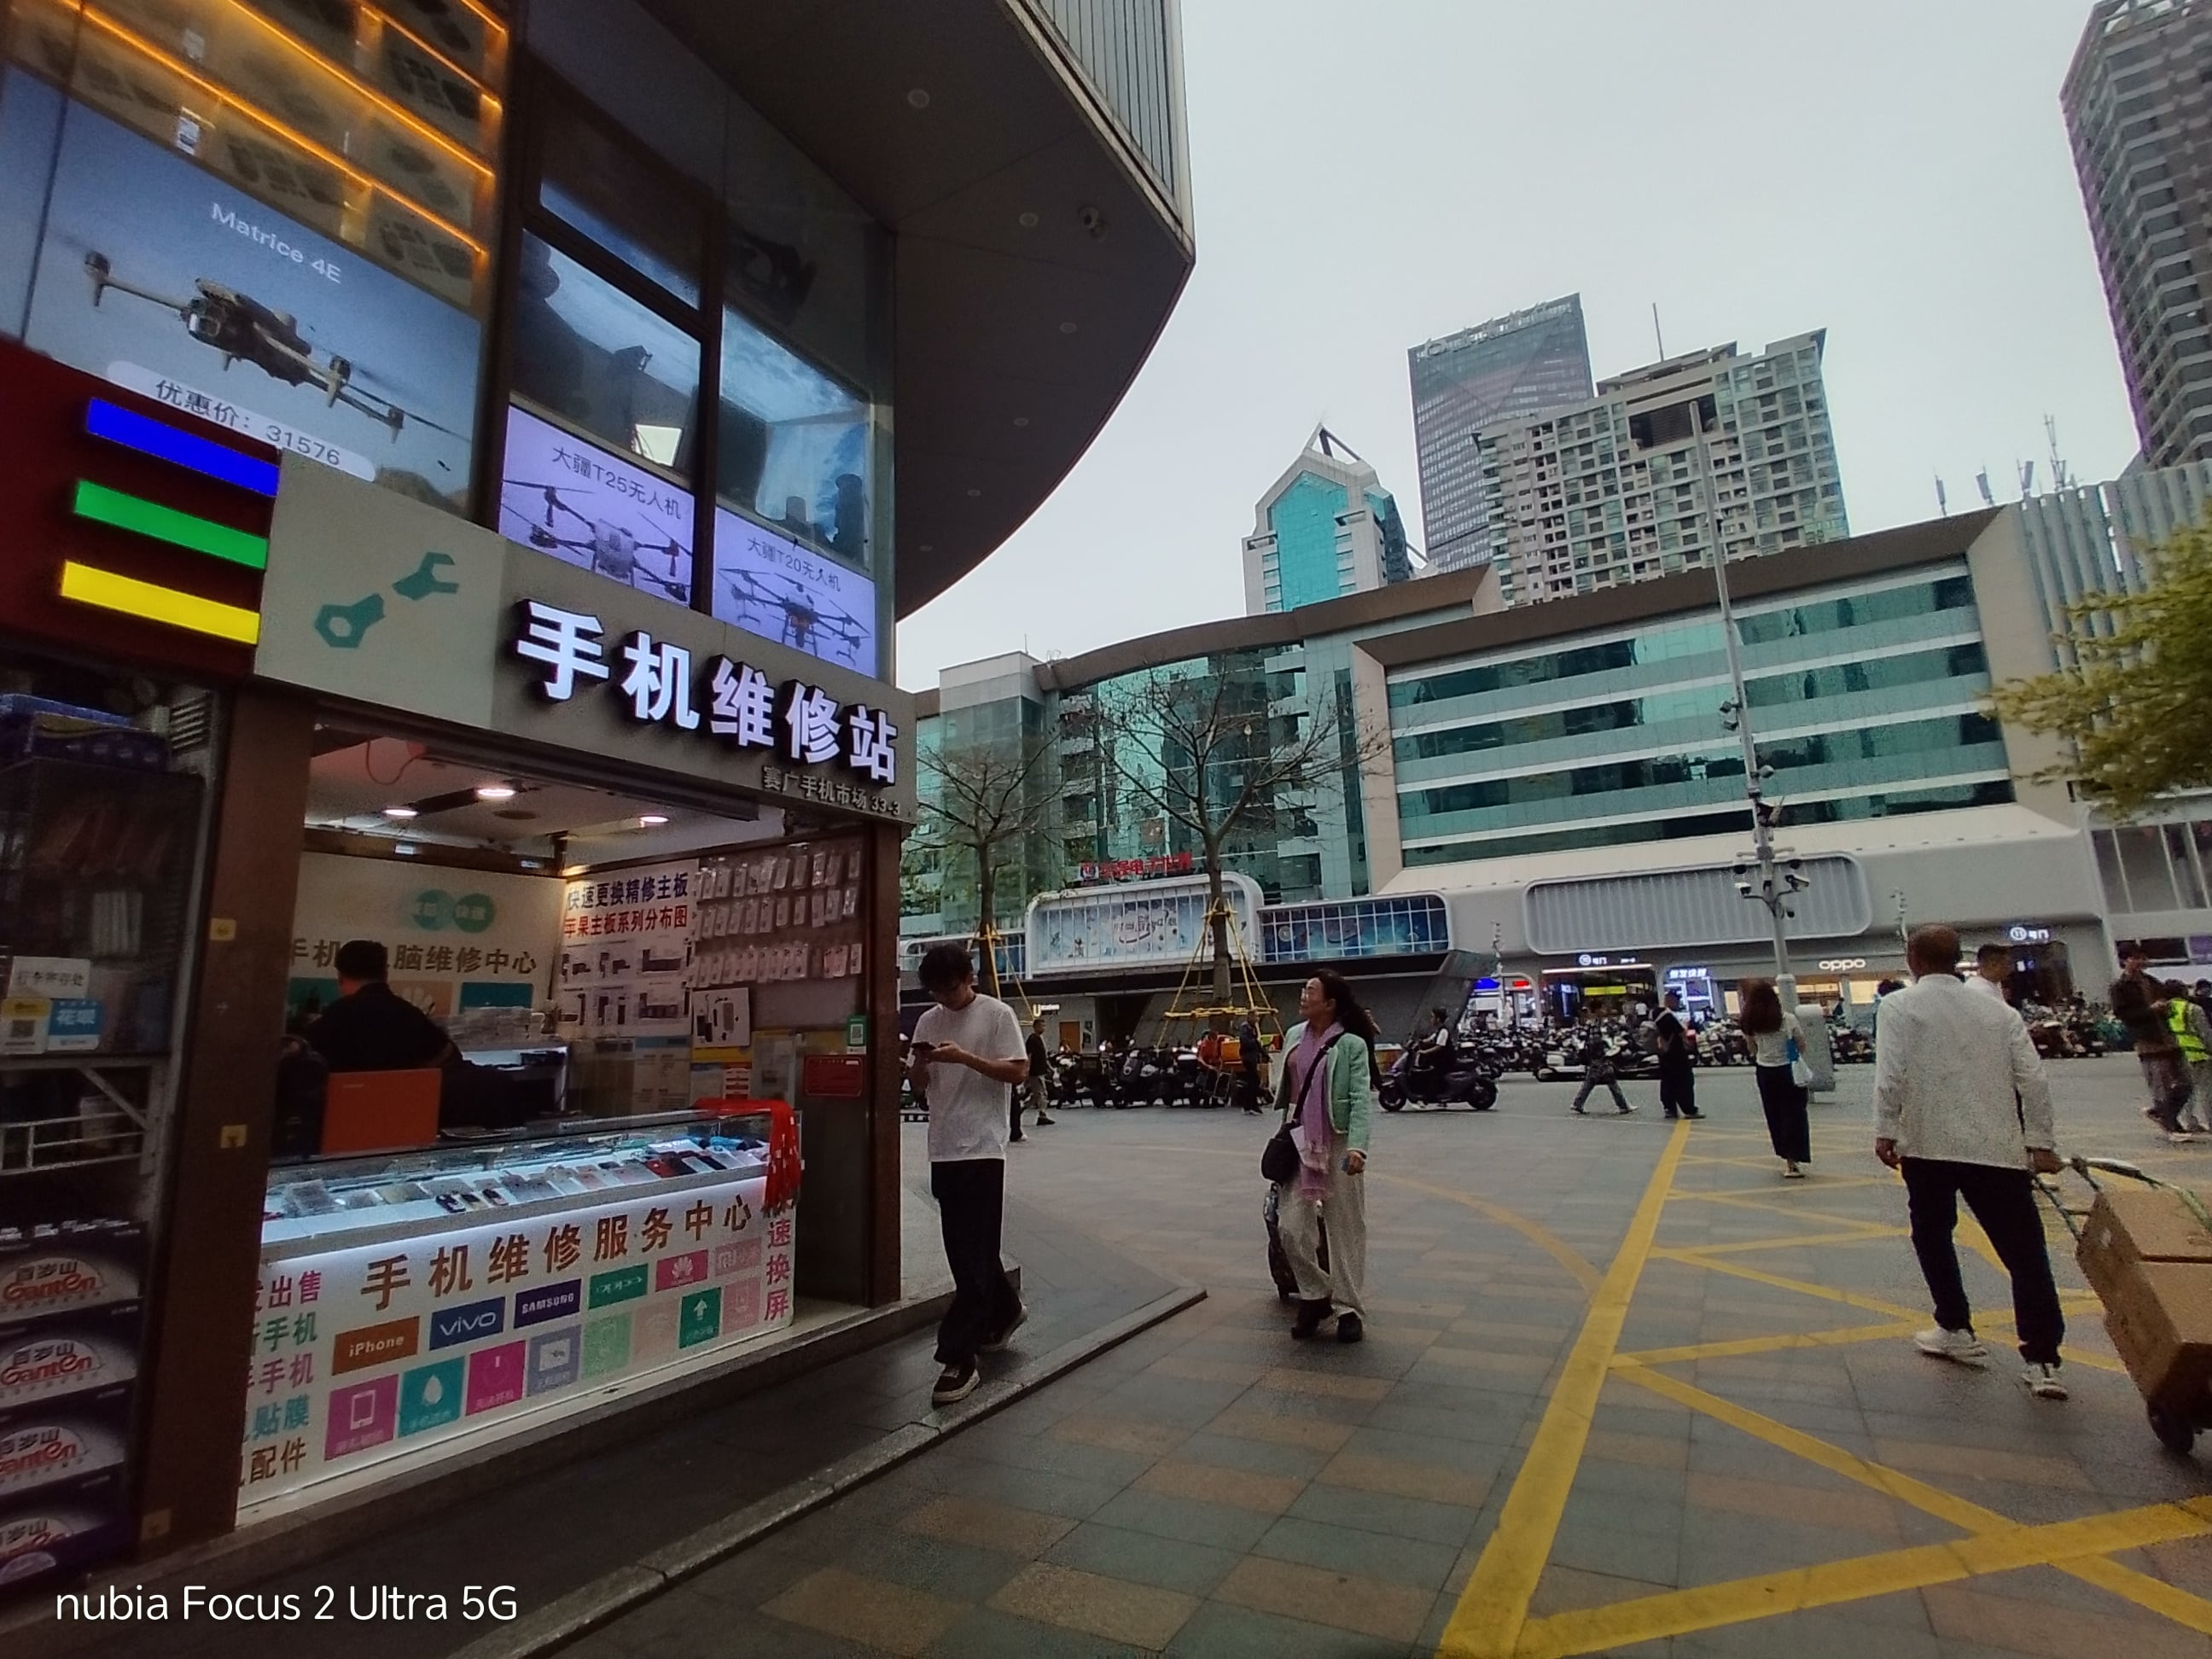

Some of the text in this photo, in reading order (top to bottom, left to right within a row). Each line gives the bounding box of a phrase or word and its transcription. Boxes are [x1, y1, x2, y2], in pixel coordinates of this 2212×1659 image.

[212, 202, 341, 284] Matrice 4E
[552, 445, 682, 520] 大疆T25无人机
[747, 536, 841, 592] 大疆T20无人机
[515, 601, 898, 785] 手机维修站
[568, 872, 689, 911] 快速更换精修主板
[564, 905, 688, 939] 苹果主板系列分布图
[360, 1194, 753, 1311] 手机维修服务中心
[521, 1292, 575, 1314] SAMSUNG
[12, 1342, 75, 1366] 百岁山
[348, 1335, 405, 1358] iPhone
[240, 1436, 307, 1487] 配件
